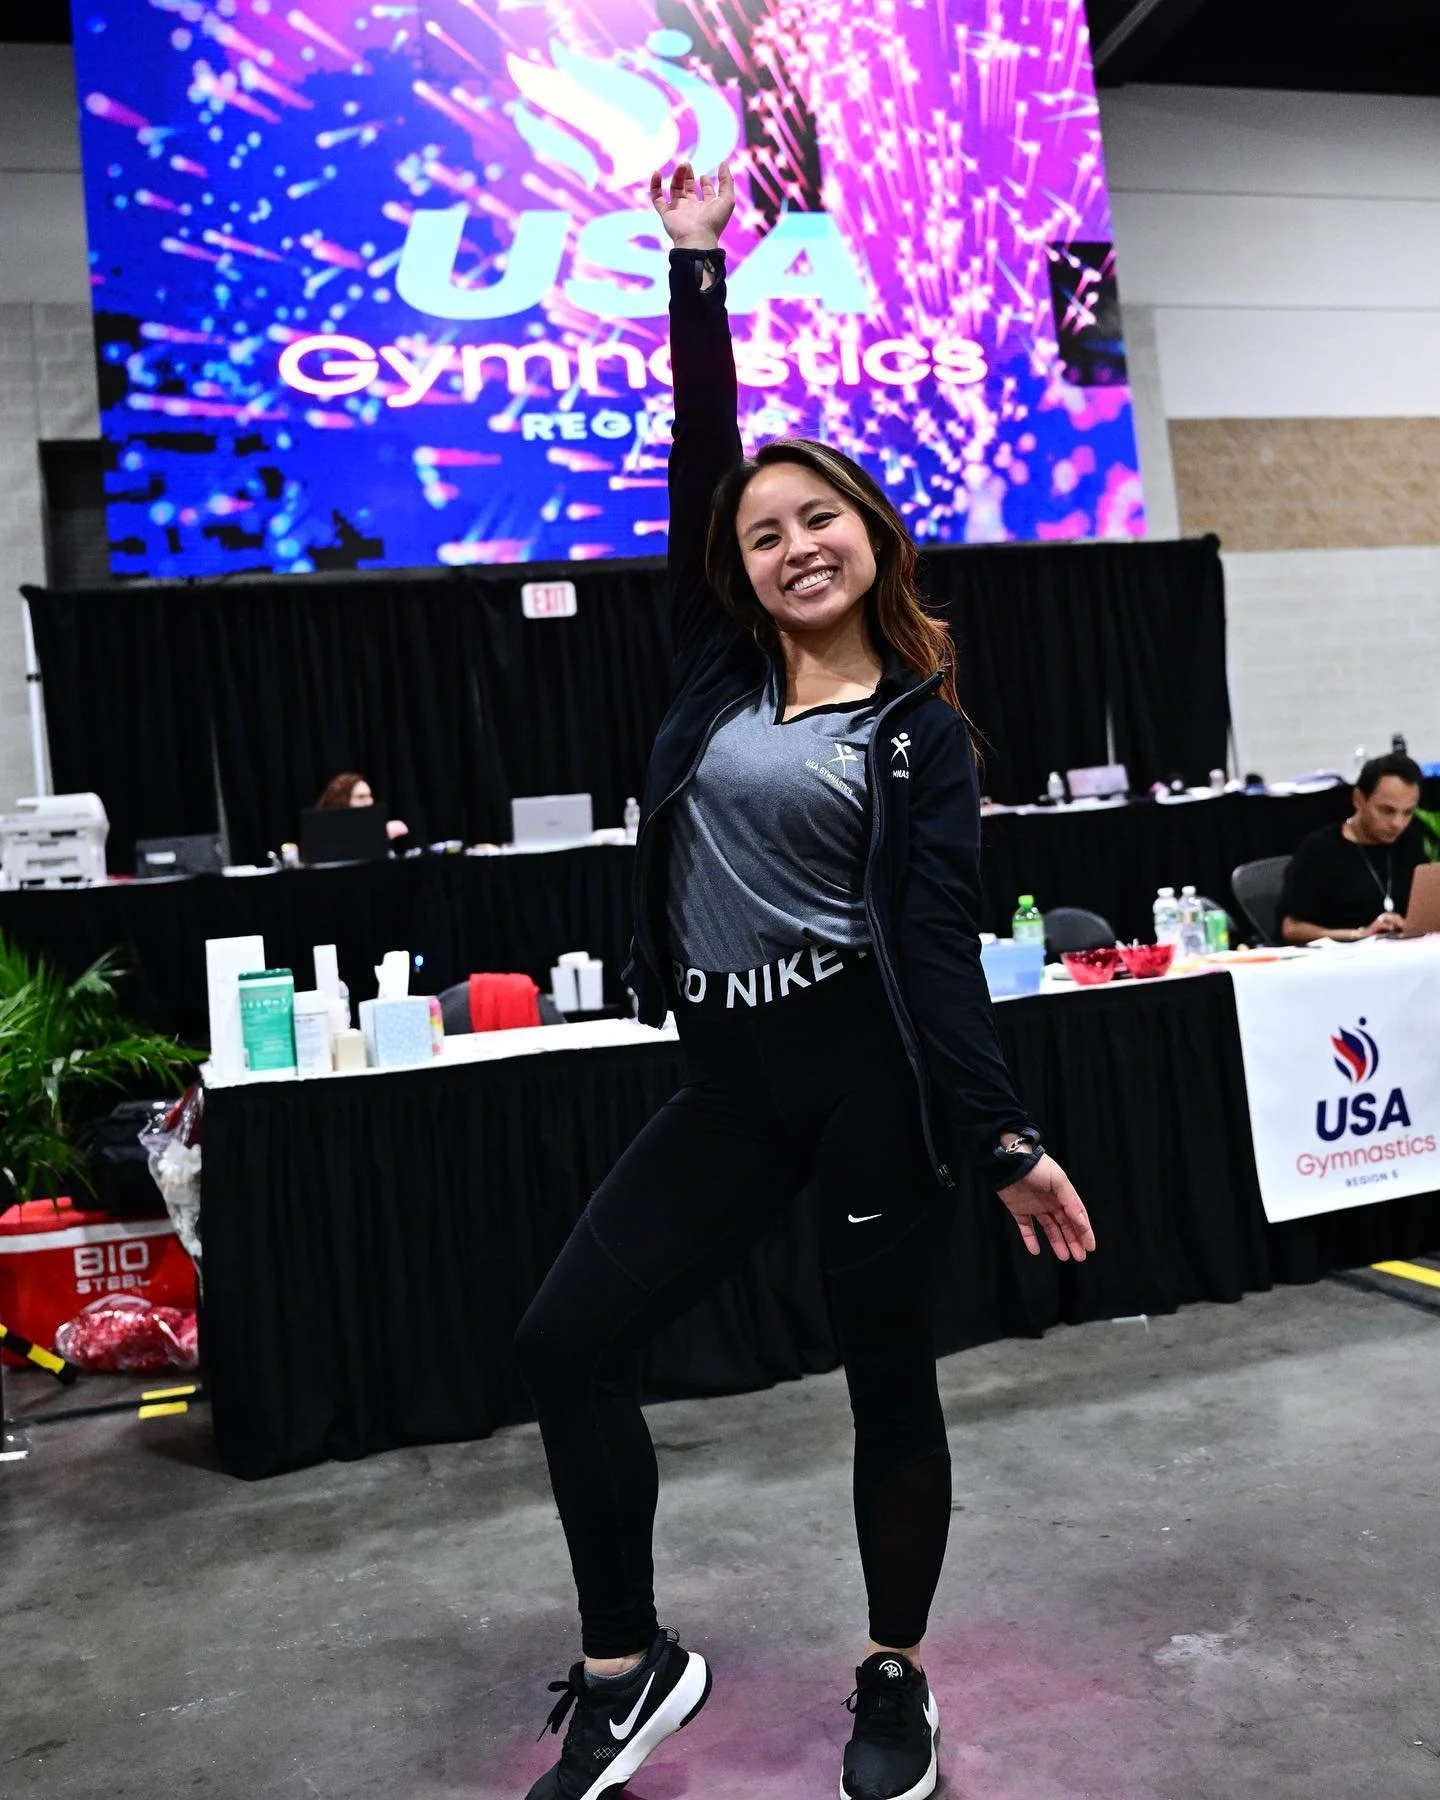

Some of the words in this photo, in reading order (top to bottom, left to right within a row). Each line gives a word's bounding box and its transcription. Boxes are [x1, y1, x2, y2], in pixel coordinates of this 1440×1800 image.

[394, 207, 873, 320] USA
[532, 586, 567, 613] EXIT
[805, 758, 818, 771] USA
[819, 765, 854, 797] GYMNASTICS
[726, 944, 844, 1009] NIKE
[1316, 1087, 1412, 1142] USA
[1296, 1134, 1437, 1178] Gymnastics
[1345, 1171, 1388, 1187] REGION
[73, 1240, 150, 1279] BIO
[76, 1273, 151, 1295] STEEL
